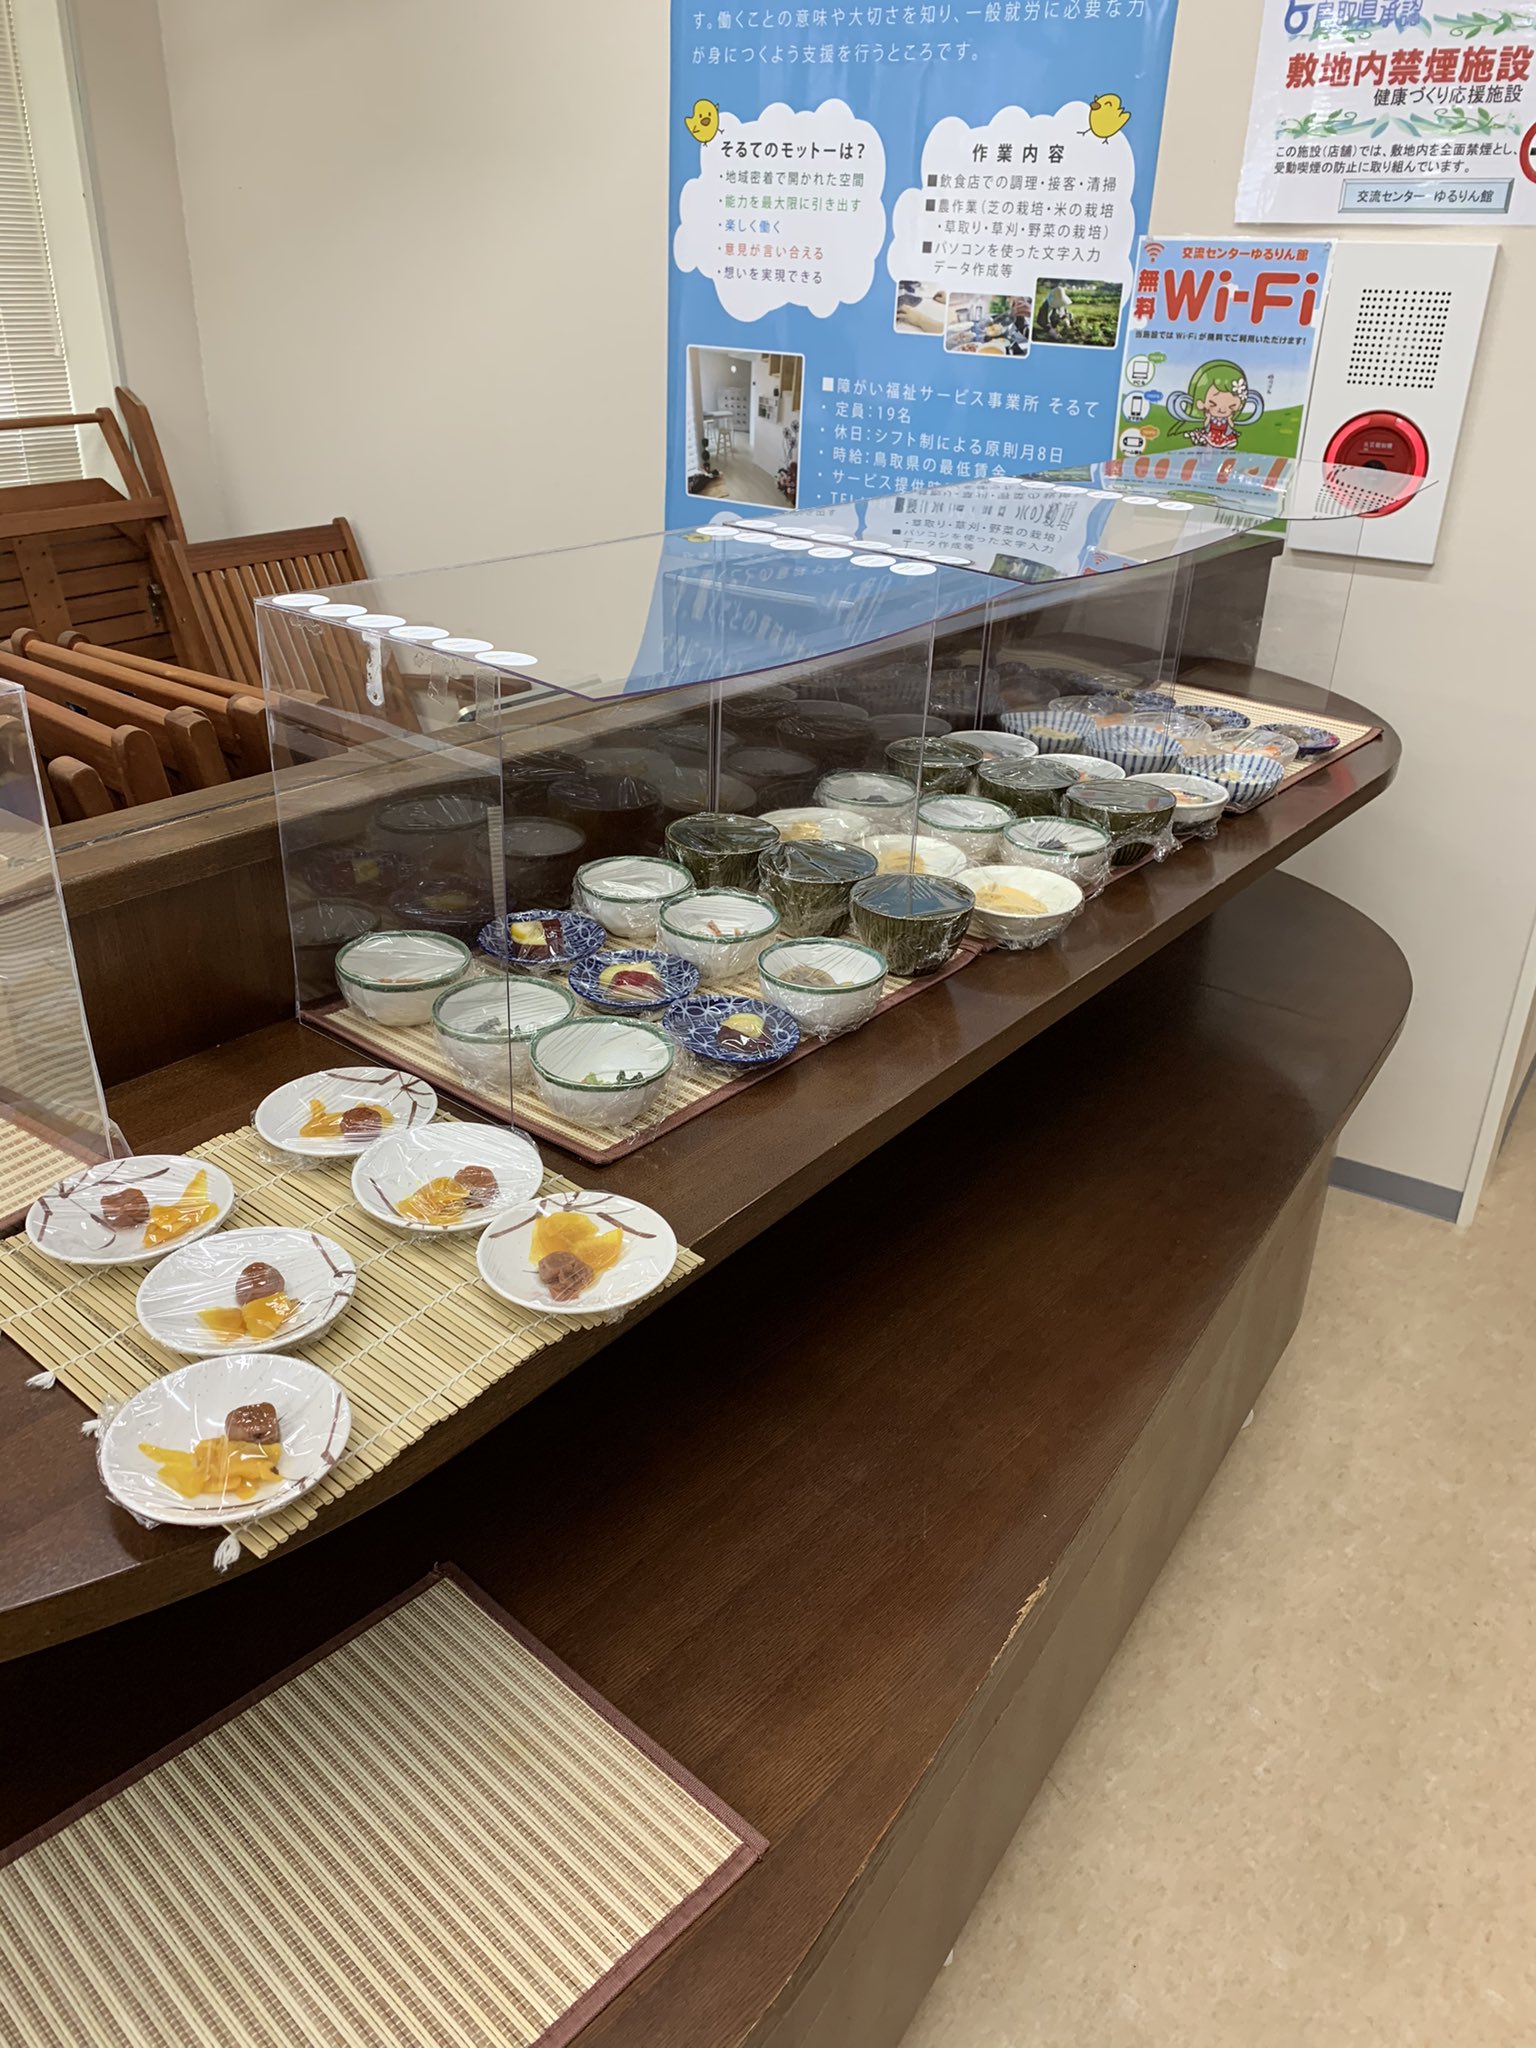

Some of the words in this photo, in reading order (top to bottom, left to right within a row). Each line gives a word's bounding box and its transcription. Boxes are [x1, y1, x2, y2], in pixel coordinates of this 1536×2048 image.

[692, 41, 980, 65] が身につくよう支援を行うところです。
[1286, 45, 1534, 89] 敷地内禁煙施設
[1373, 84, 1524, 107] 健康づくり応援施設
[721, 140, 866, 160] そるてのモットーは？
[972, 143, 1066, 164] 作業内容
[1274, 159, 1470, 175] 受動喫煙の防止に取り組んでいます。
[1356, 190, 1425, 204] 交流センター
[1434, 189, 1495, 203] ゆるりん館
[934, 241, 1101, 263] パソコンを使った文字入力
[933, 260, 1014, 279] データ作成等
[1134, 268, 1160, 321] 無料
[1163, 268, 1320, 327] Wi-Fi
[836, 377, 1040, 413] 障がい福祉サービス事業所
[1048, 396, 1100, 418] そるて
